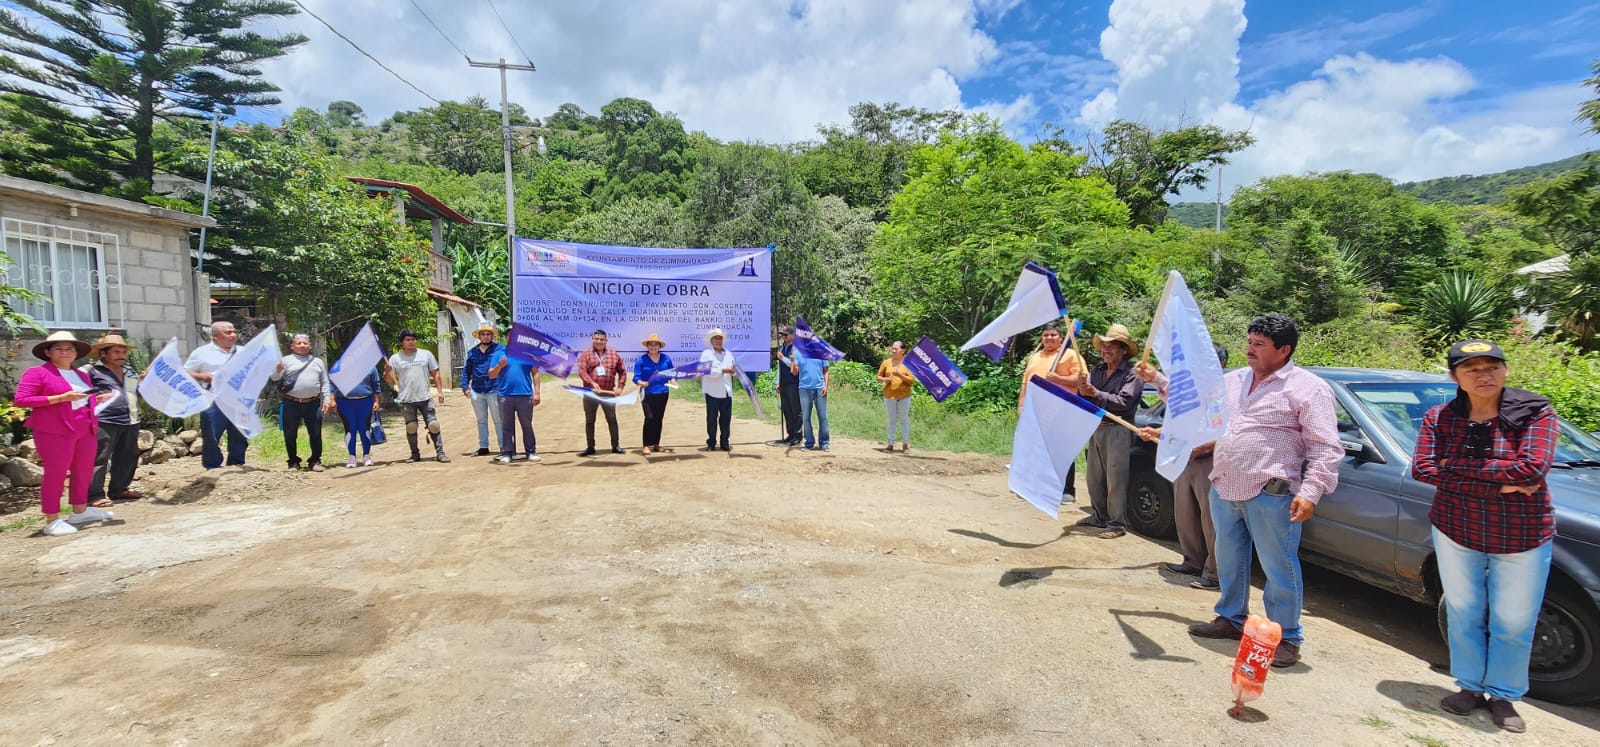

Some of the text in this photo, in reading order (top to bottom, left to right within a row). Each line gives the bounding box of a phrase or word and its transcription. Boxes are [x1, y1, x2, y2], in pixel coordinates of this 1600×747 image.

[586, 255, 646, 263] AYUNTAMIENTO
[583, 282, 710, 297] INICIO DE OBRA
[561, 299, 624, 308] CONSTRUCCIÓN
[517, 334, 540, 347] INICIO
[540, 341, 551, 352] DE
[913, 345, 952, 388] INICIO DE OBRA
[168, 373, 187, 389] DE
[1168, 369, 1201, 420] OBRA
[1252, 644, 1271, 657] Cola
[1246, 650, 1272, 669] Red
